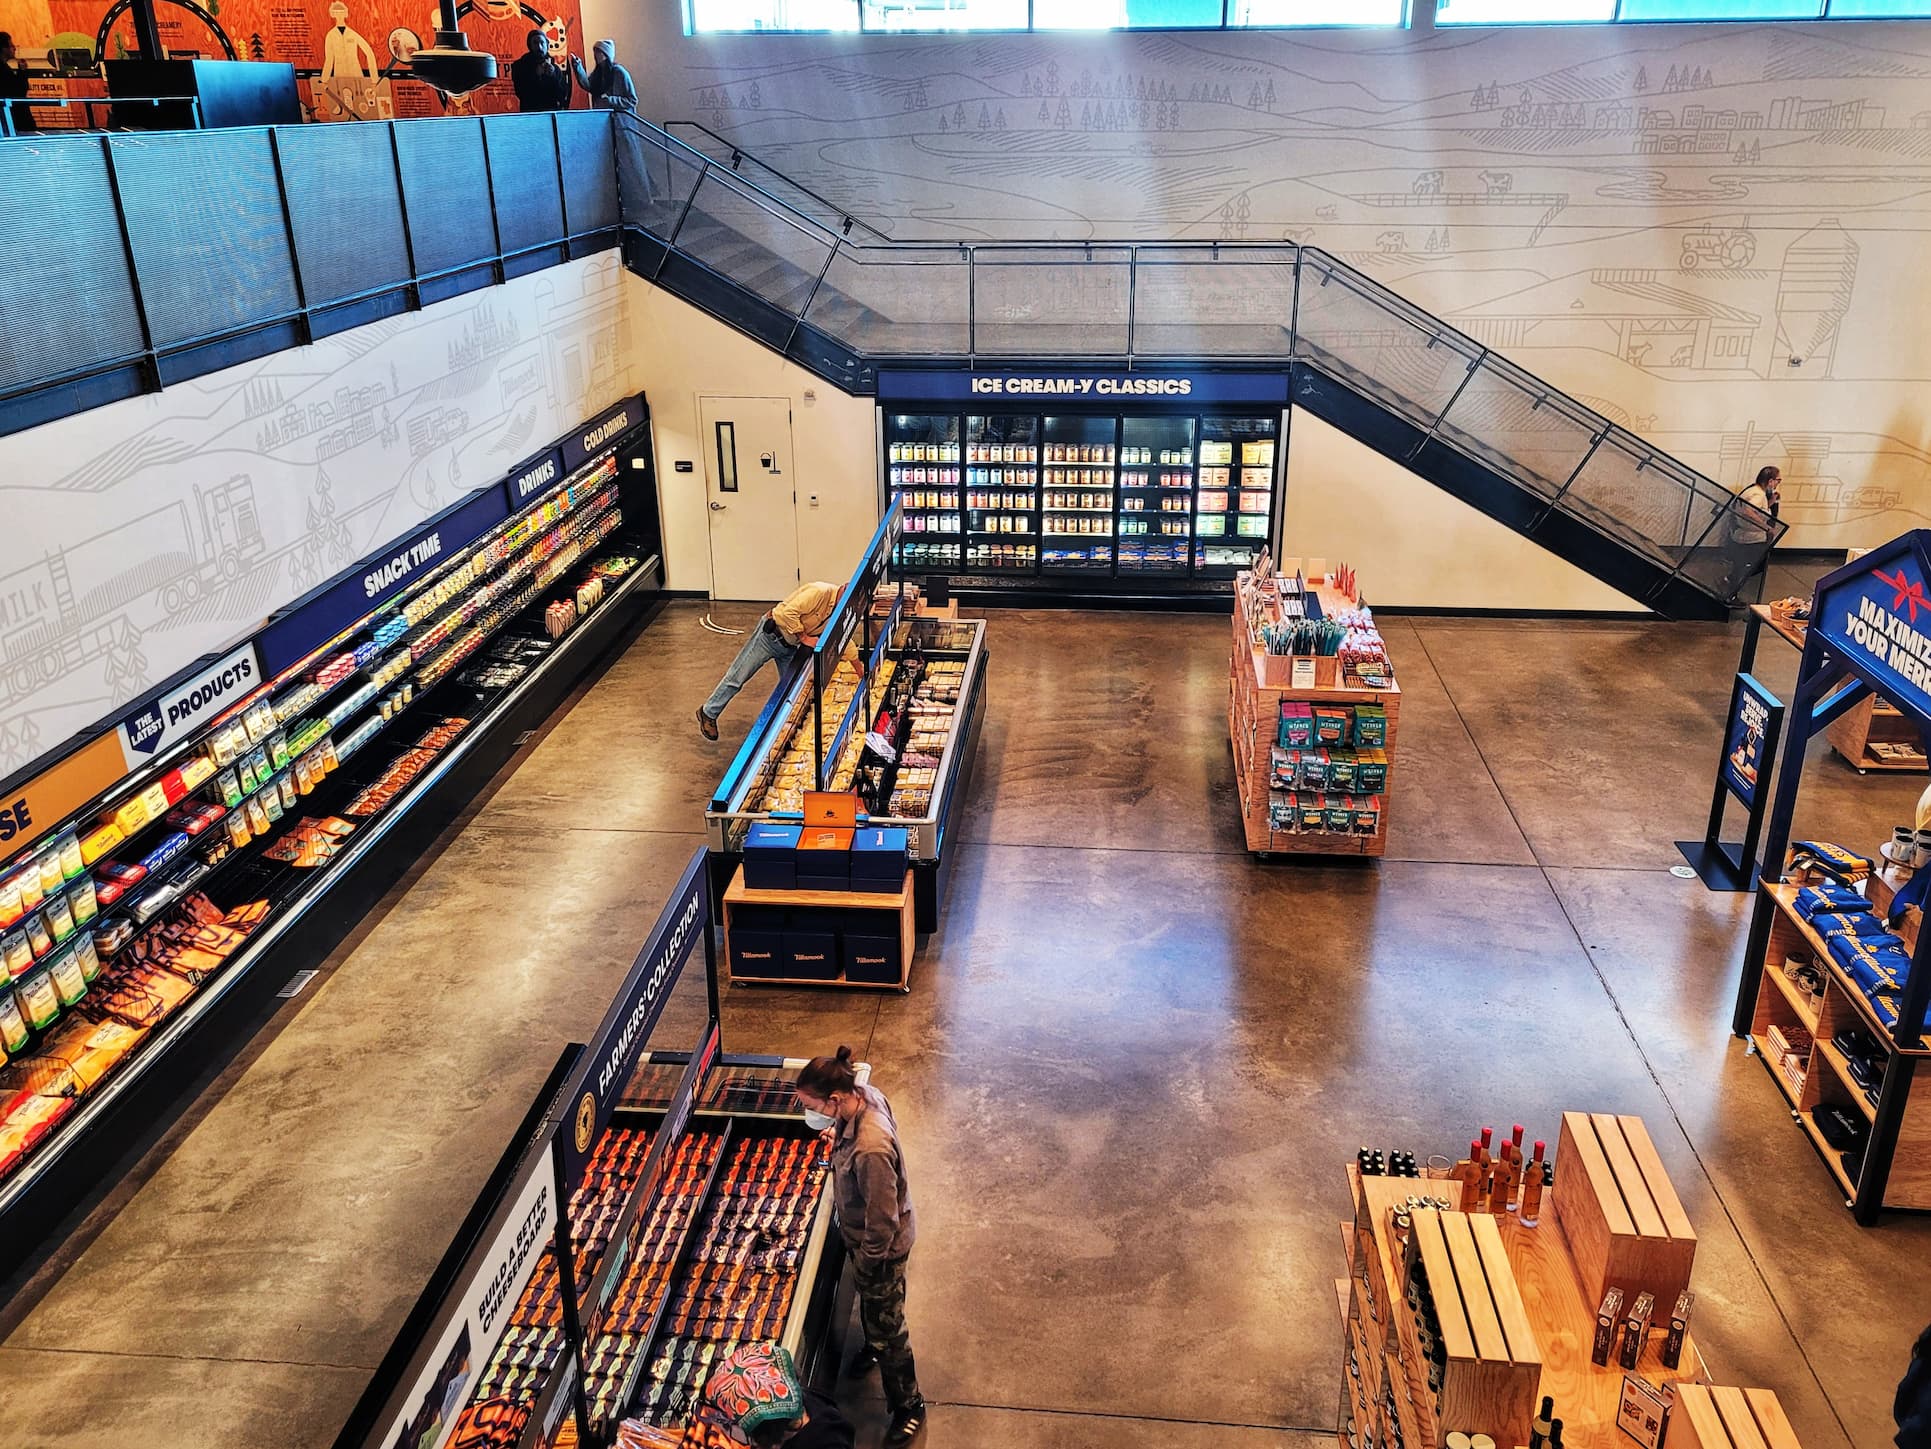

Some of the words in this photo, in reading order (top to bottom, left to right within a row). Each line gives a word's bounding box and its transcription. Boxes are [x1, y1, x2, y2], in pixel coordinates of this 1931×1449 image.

[971, 378, 1002, 393] ICE
[1005, 378, 1094, 394] CREAM-Y
[1096, 379, 1192, 395] CLASSICS
[583, 427, 605, 451] COLD
[603, 411, 628, 440] DRINKS
[518, 459, 555, 497] DRINKS
[364, 546, 413, 598] SNACK
[411, 532, 442, 566] TIME
[1845, 611, 1888, 661] YOUR
[167, 658, 251, 726] PRODUCTS
[131, 717, 164, 747] LATEST
[134, 711, 154, 730] THE
[740, 951, 771, 959] Tillamook
[794, 953, 825, 961] Tillamook
[598, 992, 648, 1097] FARMERS'
[645, 891, 699, 1001] COLLECTION
[478, 1262, 507, 1322] BUILD
[508, 1251, 517, 1264] A
[516, 1185, 548, 1246] BETTER
[482, 1205, 548, 1335] CHEESEBOARD
